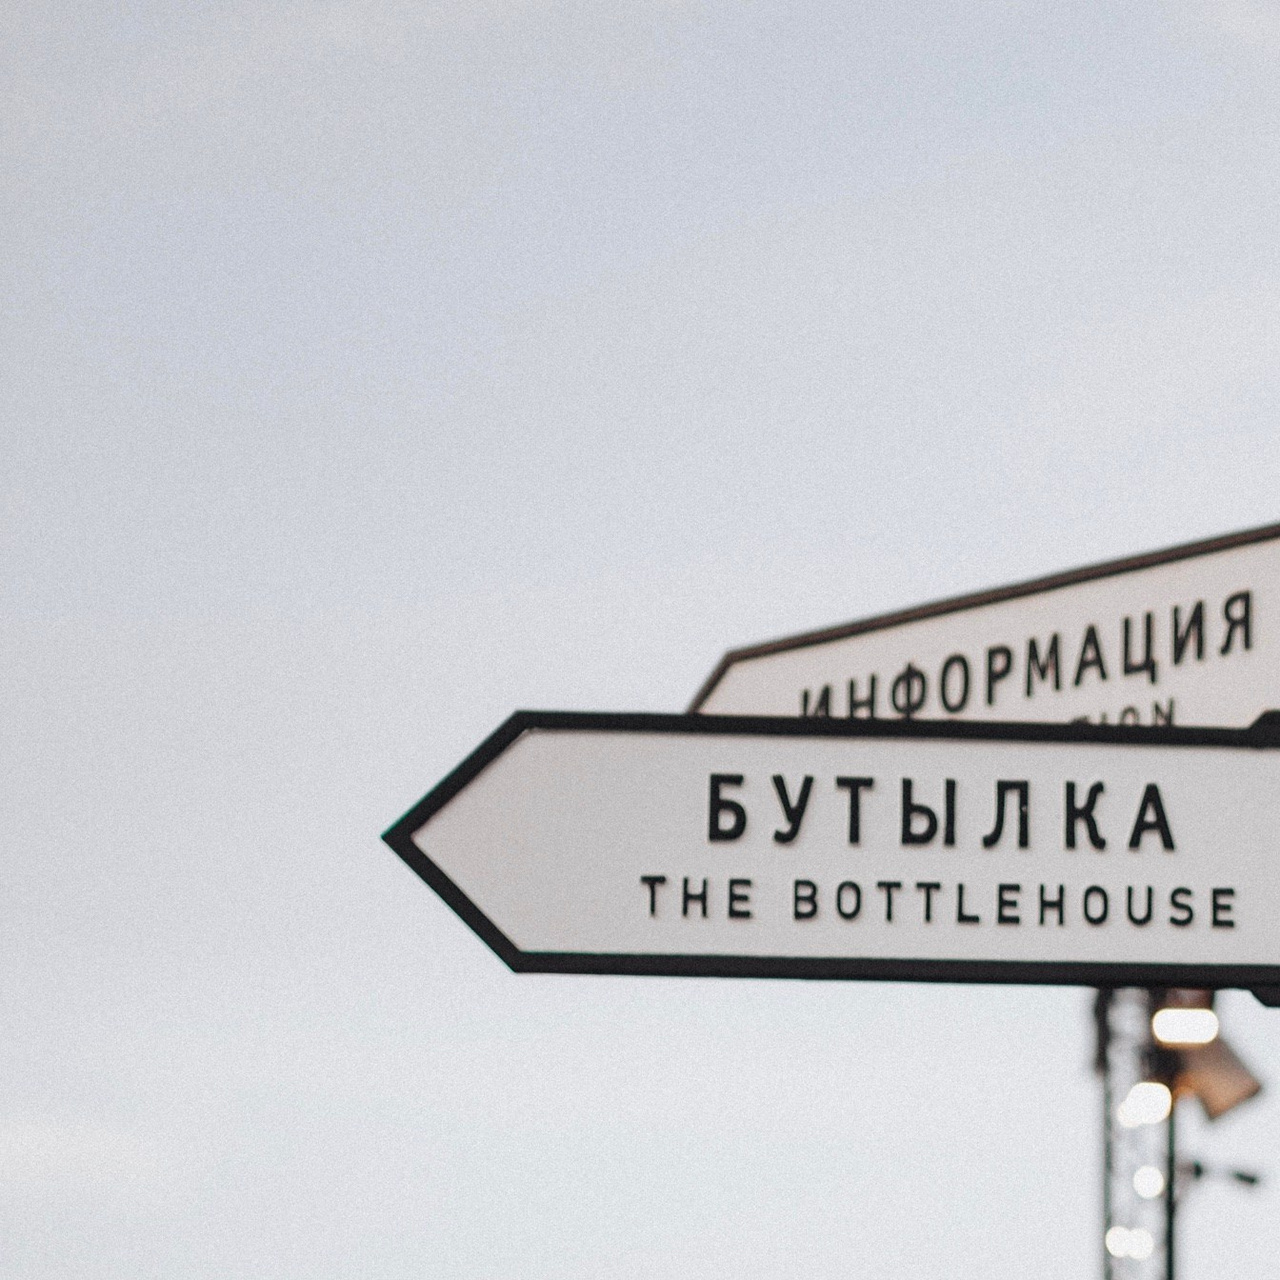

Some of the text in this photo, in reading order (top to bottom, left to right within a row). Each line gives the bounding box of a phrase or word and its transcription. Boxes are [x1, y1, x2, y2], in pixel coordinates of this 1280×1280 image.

[801, 590, 1253, 718] ИНФОРМАЦИЯ
[707, 772, 1176, 853] БУТЫЛКА
[640, 874, 1237, 930] THE BOTTLEHOUSE
